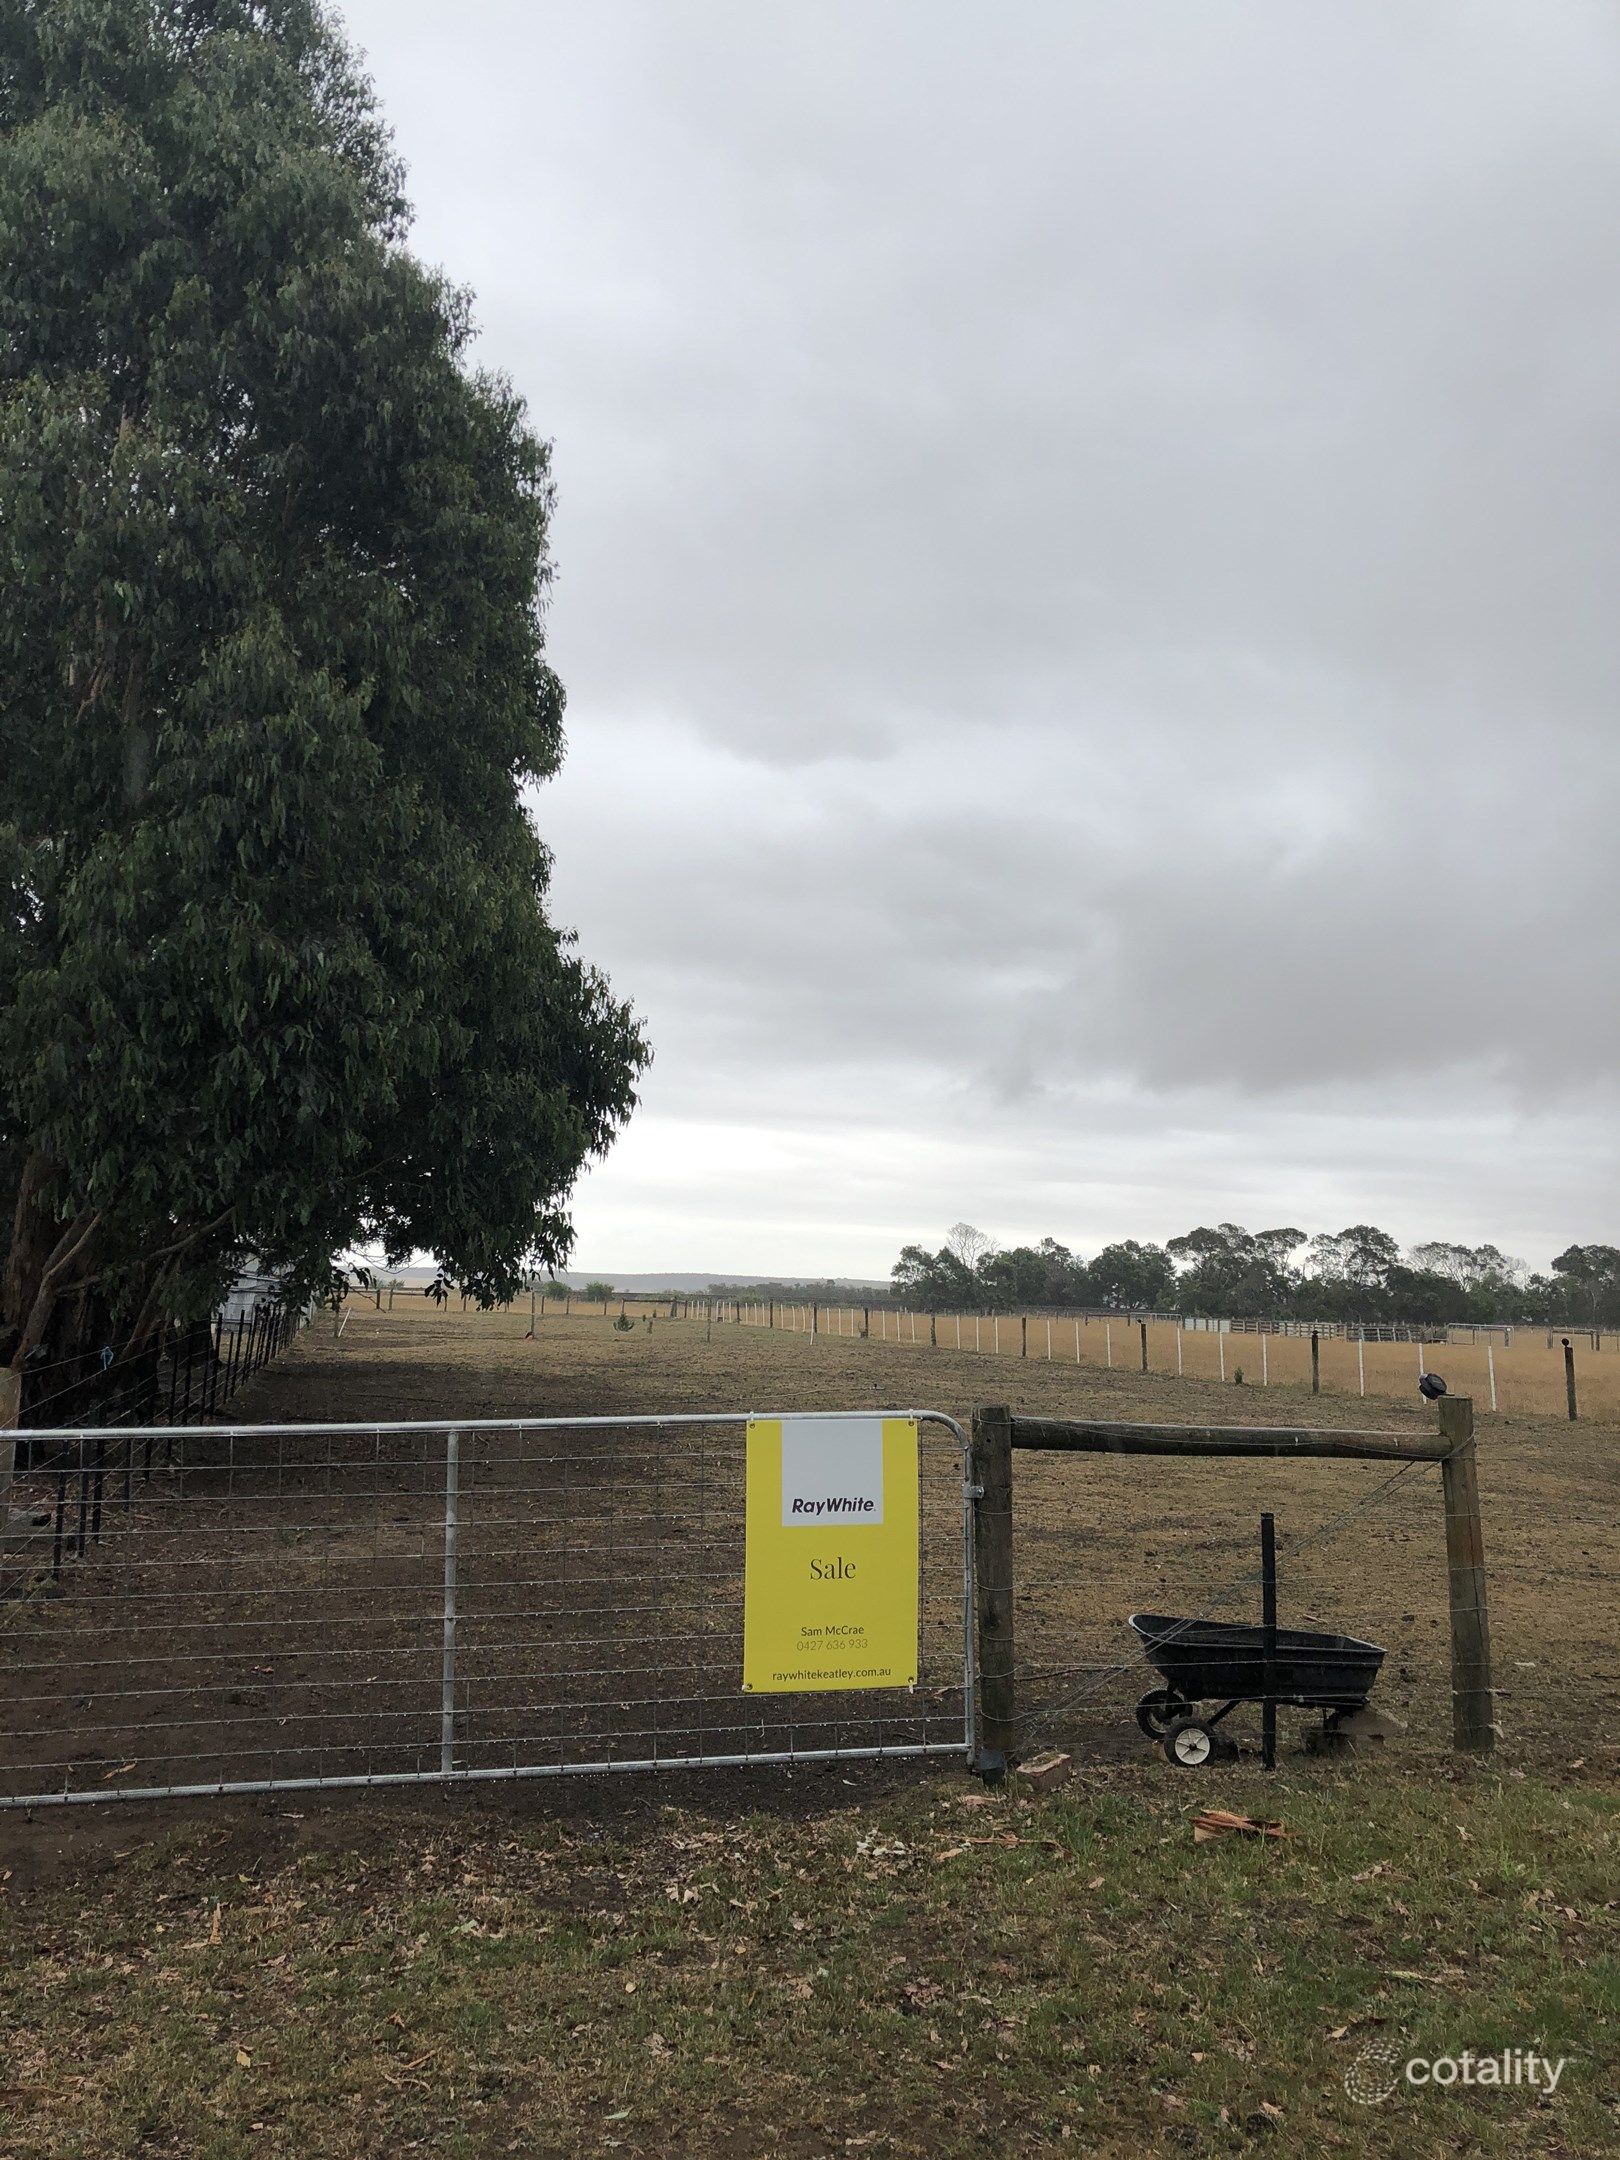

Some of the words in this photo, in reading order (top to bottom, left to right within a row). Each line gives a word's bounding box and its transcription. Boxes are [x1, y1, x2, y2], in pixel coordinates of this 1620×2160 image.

[809, 1556, 857, 1581] Sale
[800, 1626, 822, 1637] Sam
[825, 1625, 865, 1636] McCrae
[796, 1640, 824, 1651] 0427
[826, 1639, 846, 1650] 636
[848, 1638, 869, 1649] 933
[772, 1666, 892, 1682] raywhitekeatley.com.au
